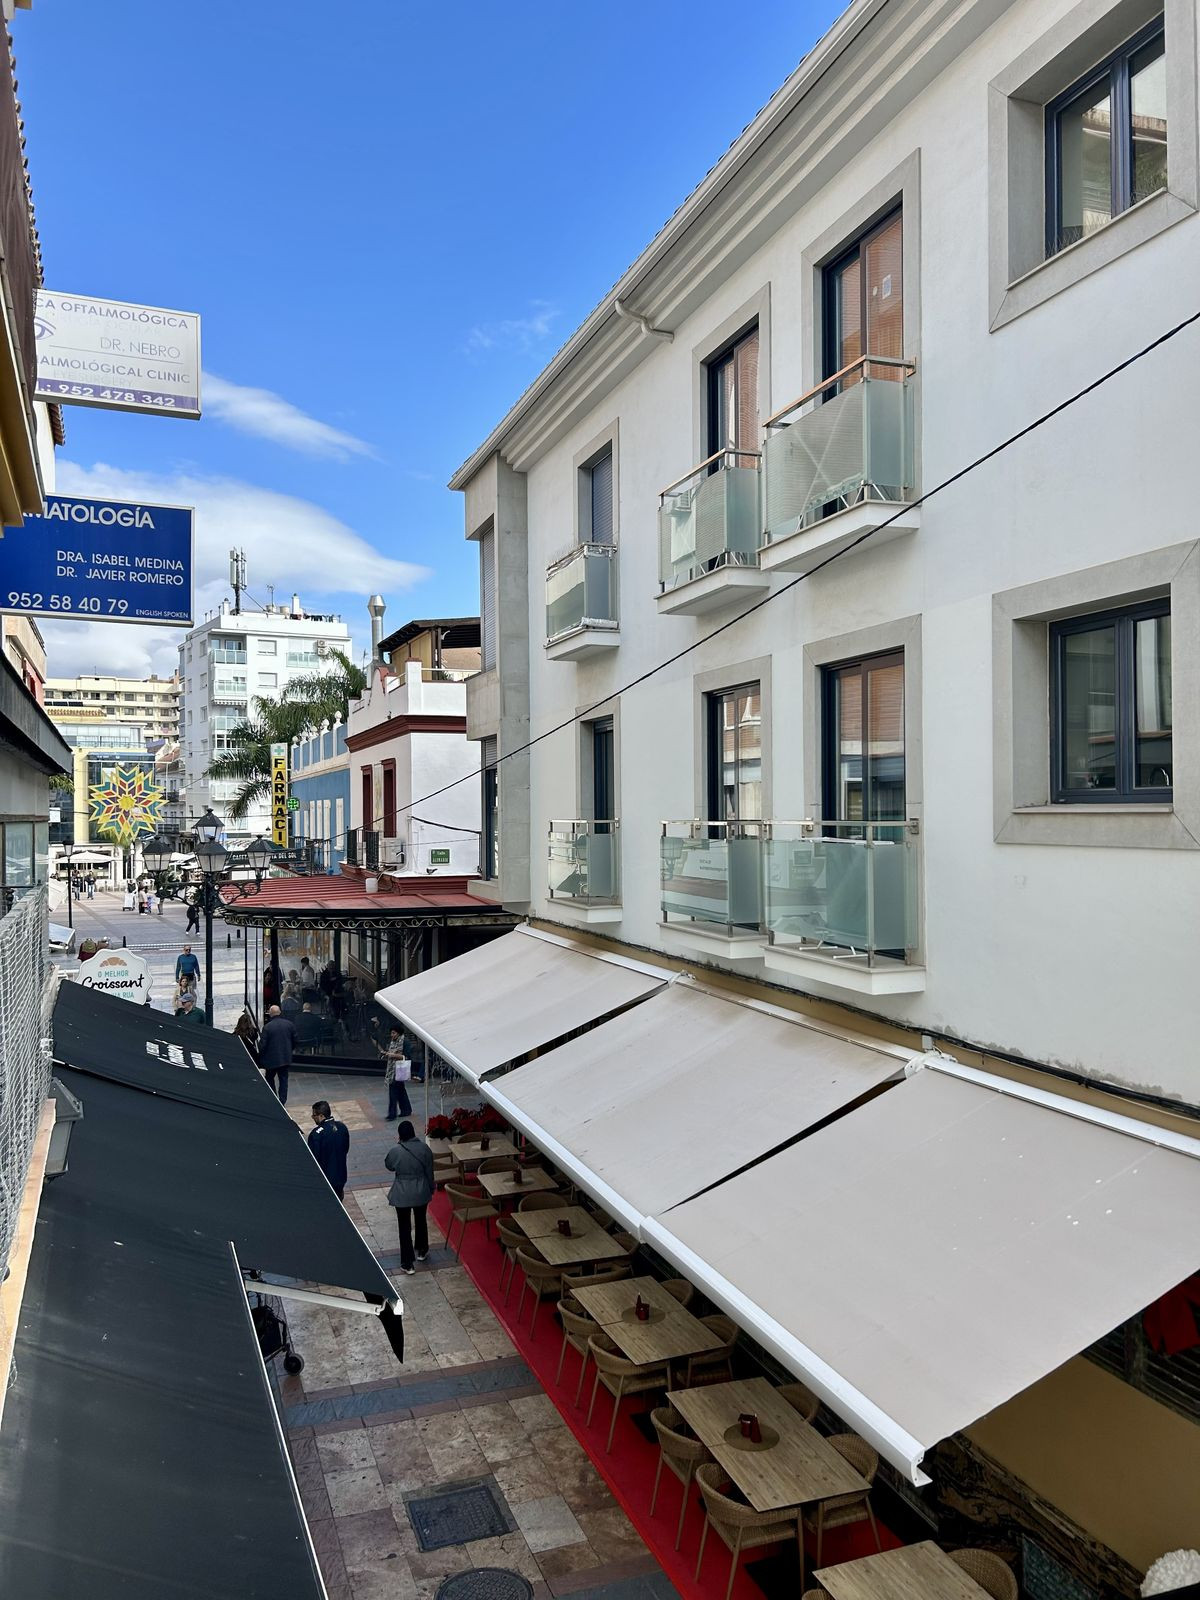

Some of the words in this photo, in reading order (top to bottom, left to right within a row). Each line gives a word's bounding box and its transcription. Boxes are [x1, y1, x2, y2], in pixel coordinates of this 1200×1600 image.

[61, 301, 188, 329] OFTALMOLÓGICA
[100, 336, 125, 352] DR.
[130, 341, 181, 359] NEBRO
[37, 355, 143, 378] ALMOLÓGICAL
[147, 369, 190, 384] CLINIC
[59, 384, 94, 398] 952
[100, 389, 135, 402] 478
[142, 394, 176, 407] 342
[23, 501, 155, 529] ATOLOGÍA
[57, 550, 87, 563] DRA.
[92, 553, 131, 567] ISABEL
[135, 557, 184, 571] MEDINA
[57, 566, 78, 578] DR.
[86, 569, 125, 581] JAVIER
[129, 572, 184, 586] ROMERO
[8, 592, 43, 608] 952
[49, 595, 72, 610] 58
[78, 597, 101, 612] 40
[108, 599, 129, 614] 79
[135, 609, 163, 617] ENGLISH
[163, 611, 189, 619] SPOKEN
[81, 973, 145, 989] Croissant
[105, 970, 129, 978] MELHOR
[123, 991, 135, 999] RUA
